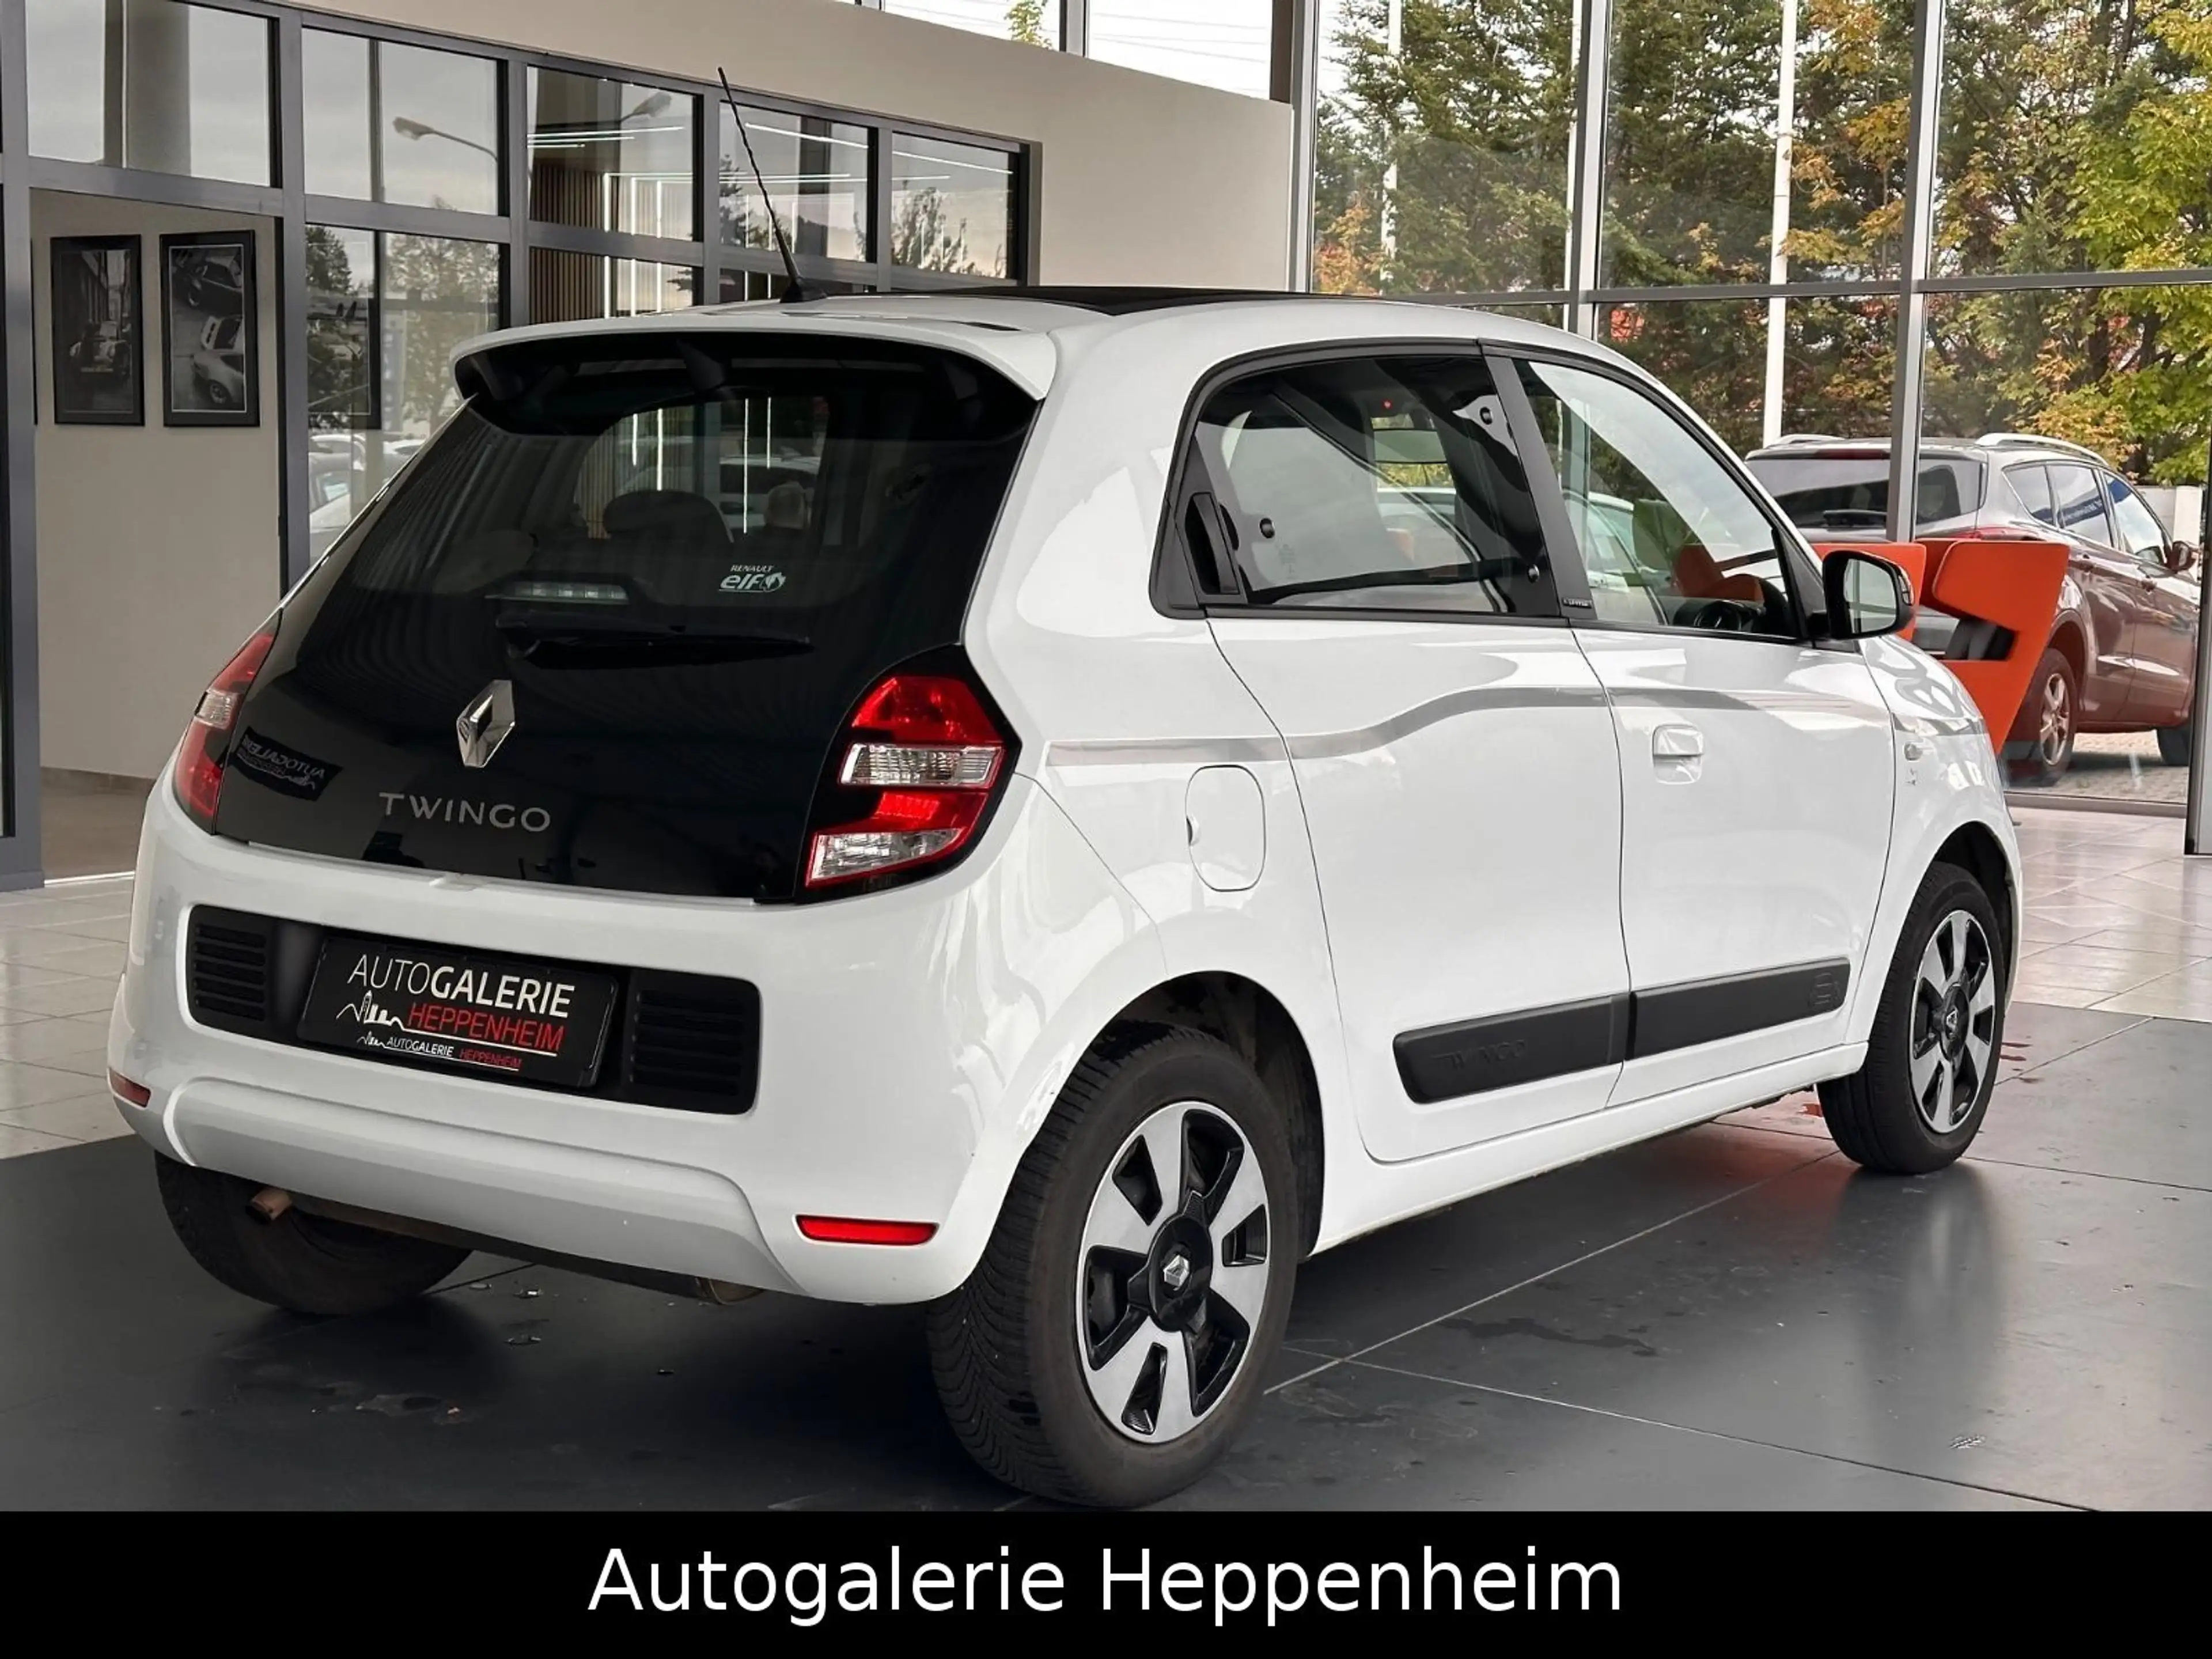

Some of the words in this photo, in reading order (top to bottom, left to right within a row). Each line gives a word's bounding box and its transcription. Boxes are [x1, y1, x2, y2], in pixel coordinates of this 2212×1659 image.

[720, 574, 765, 589] elf
[730, 564, 774, 572] RENAULT
[378, 791, 551, 832] TWINGO
[347, 954, 575, 1018] AUTOGALERIE
[407, 1002, 565, 1051] HEPPENHEIM
[387, 1036, 454, 1056] AUTOGALERIE
[459, 1048, 522, 1068] HEPPENHEIM
